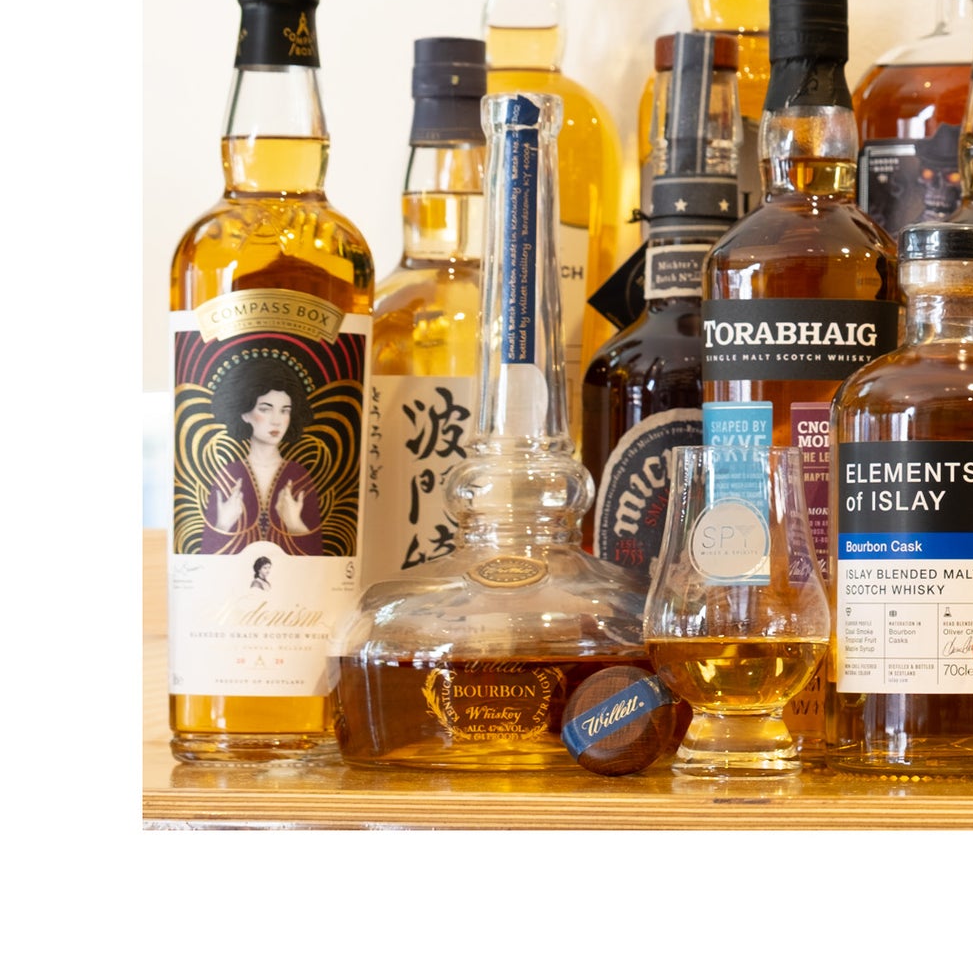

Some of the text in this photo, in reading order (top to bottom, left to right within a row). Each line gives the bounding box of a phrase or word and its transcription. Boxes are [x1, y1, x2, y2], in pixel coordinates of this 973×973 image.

[520, 243, 532, 283] Distillery
[508, 269, 517, 304] Bourbon
[211, 302, 331, 326] COMPASS BOX
[703, 319, 878, 348] TORABHAIG
[706, 353, 872, 363] SINGLE MALT SCOTCH WHISKY
[711, 420, 767, 433] SHAPED BY
[846, 490, 946, 512] of ISLAY
[845, 540, 923, 553] Bourbon Cask
[845, 569, 873, 580] ISLAY
[877, 569, 938, 580] BLENDED
[845, 584, 945, 596] SCOTCH WHISKY
[263, 632, 300, 640] SCOTCH
[453, 685, 536, 698] BOURBON
[532, 667, 552, 724] STRAIGHT
[465, 705, 522, 724] Whiskey
